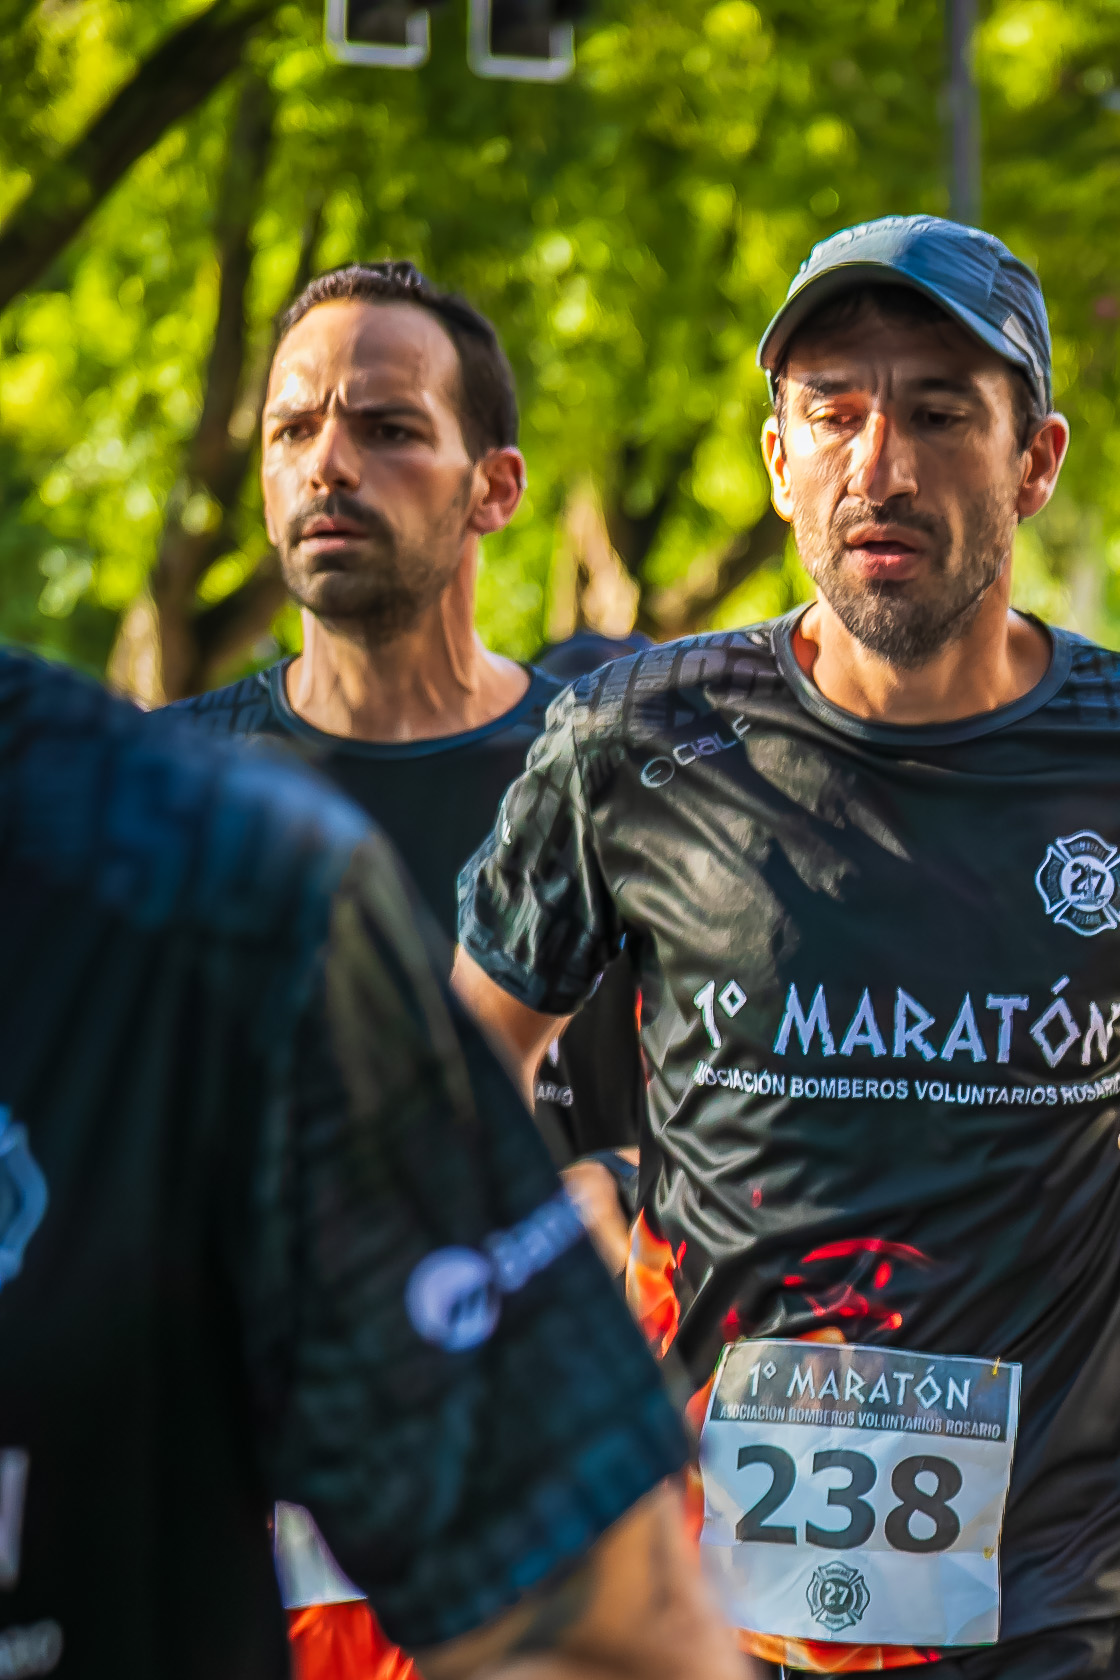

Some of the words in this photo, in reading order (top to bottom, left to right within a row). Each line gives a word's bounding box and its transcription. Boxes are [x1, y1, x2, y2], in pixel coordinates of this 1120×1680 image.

[789, 1075, 909, 1100] BOMBEROS
[915, 1080, 1058, 1106] VOLUNTARIOS
[785, 1365, 971, 1411] MARATÓN
[858, 1411, 942, 1433] VOLUNTARIOS
[945, 1419, 1001, 1439] ROSARIO
[735, 1444, 963, 1554] 238
[823, 1582, 849, 1606] 27
